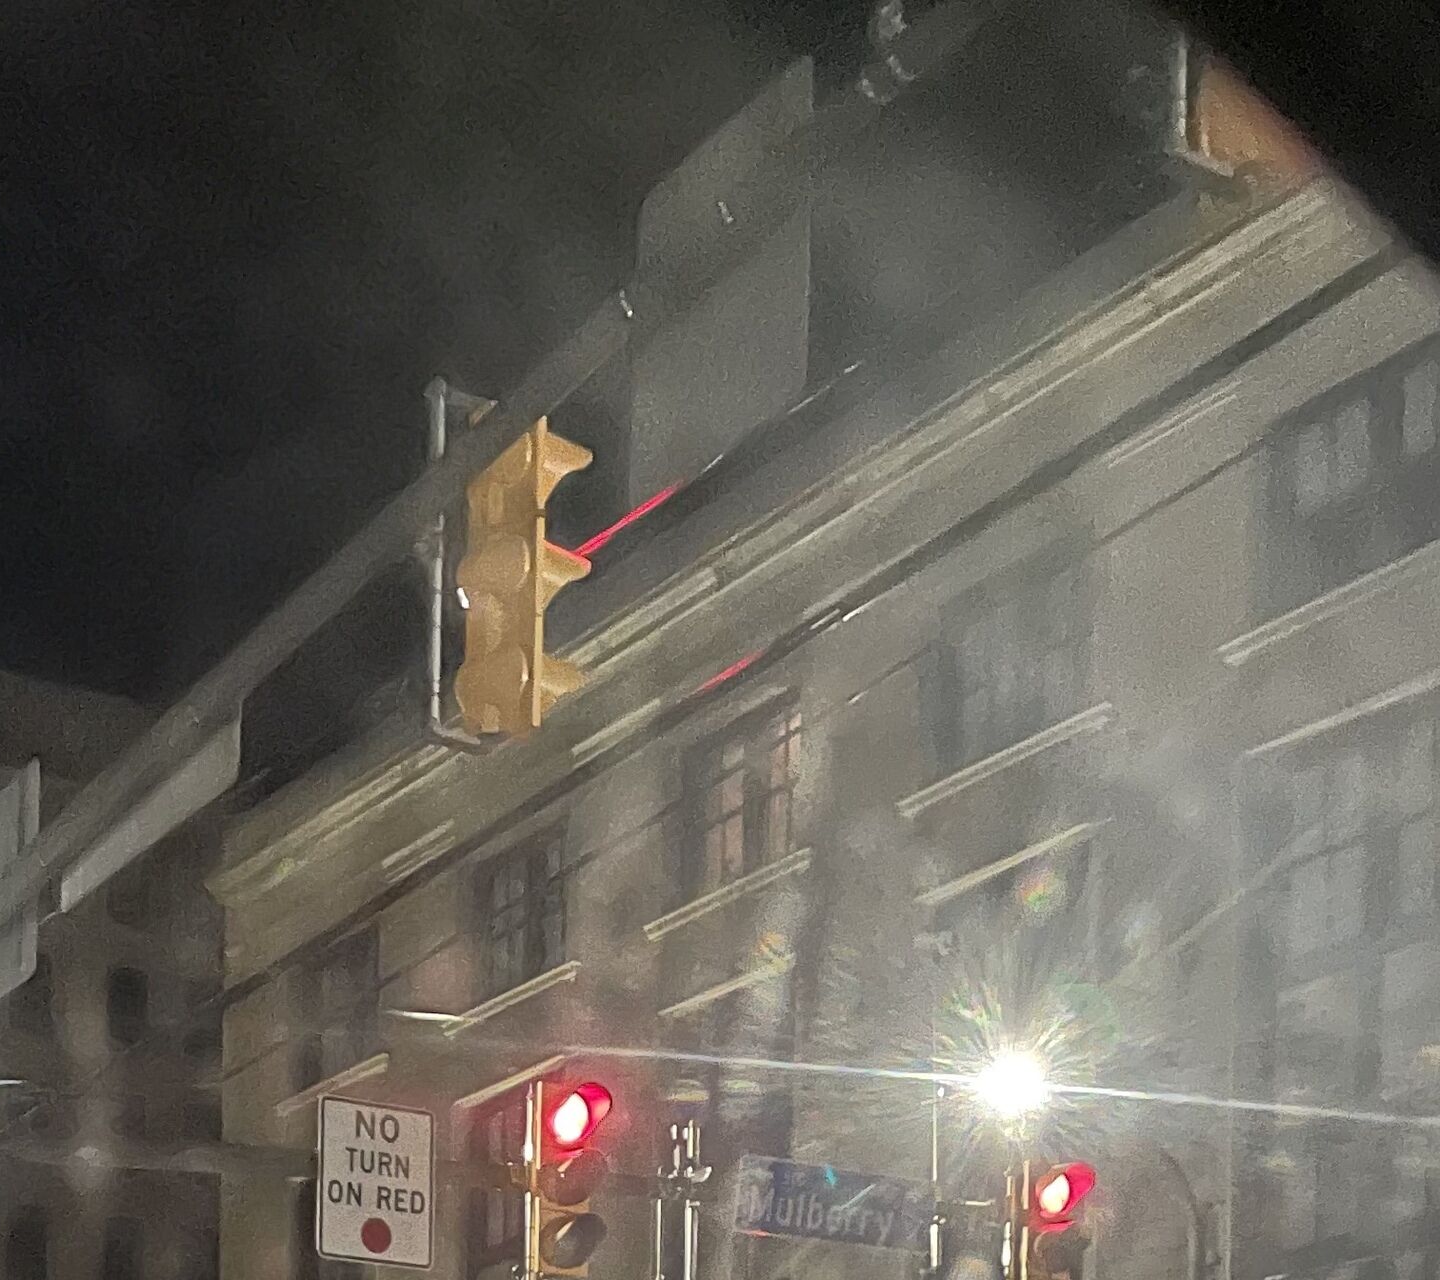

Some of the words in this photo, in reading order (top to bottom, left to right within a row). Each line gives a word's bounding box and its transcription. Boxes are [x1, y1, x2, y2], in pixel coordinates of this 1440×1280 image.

[355, 1110, 400, 1143] NO
[345, 1147, 410, 1179] TURN
[327, 1180, 362, 1207] ON
[376, 1186, 426, 1214] RED
[744, 1184, 895, 1246] Mulberry
